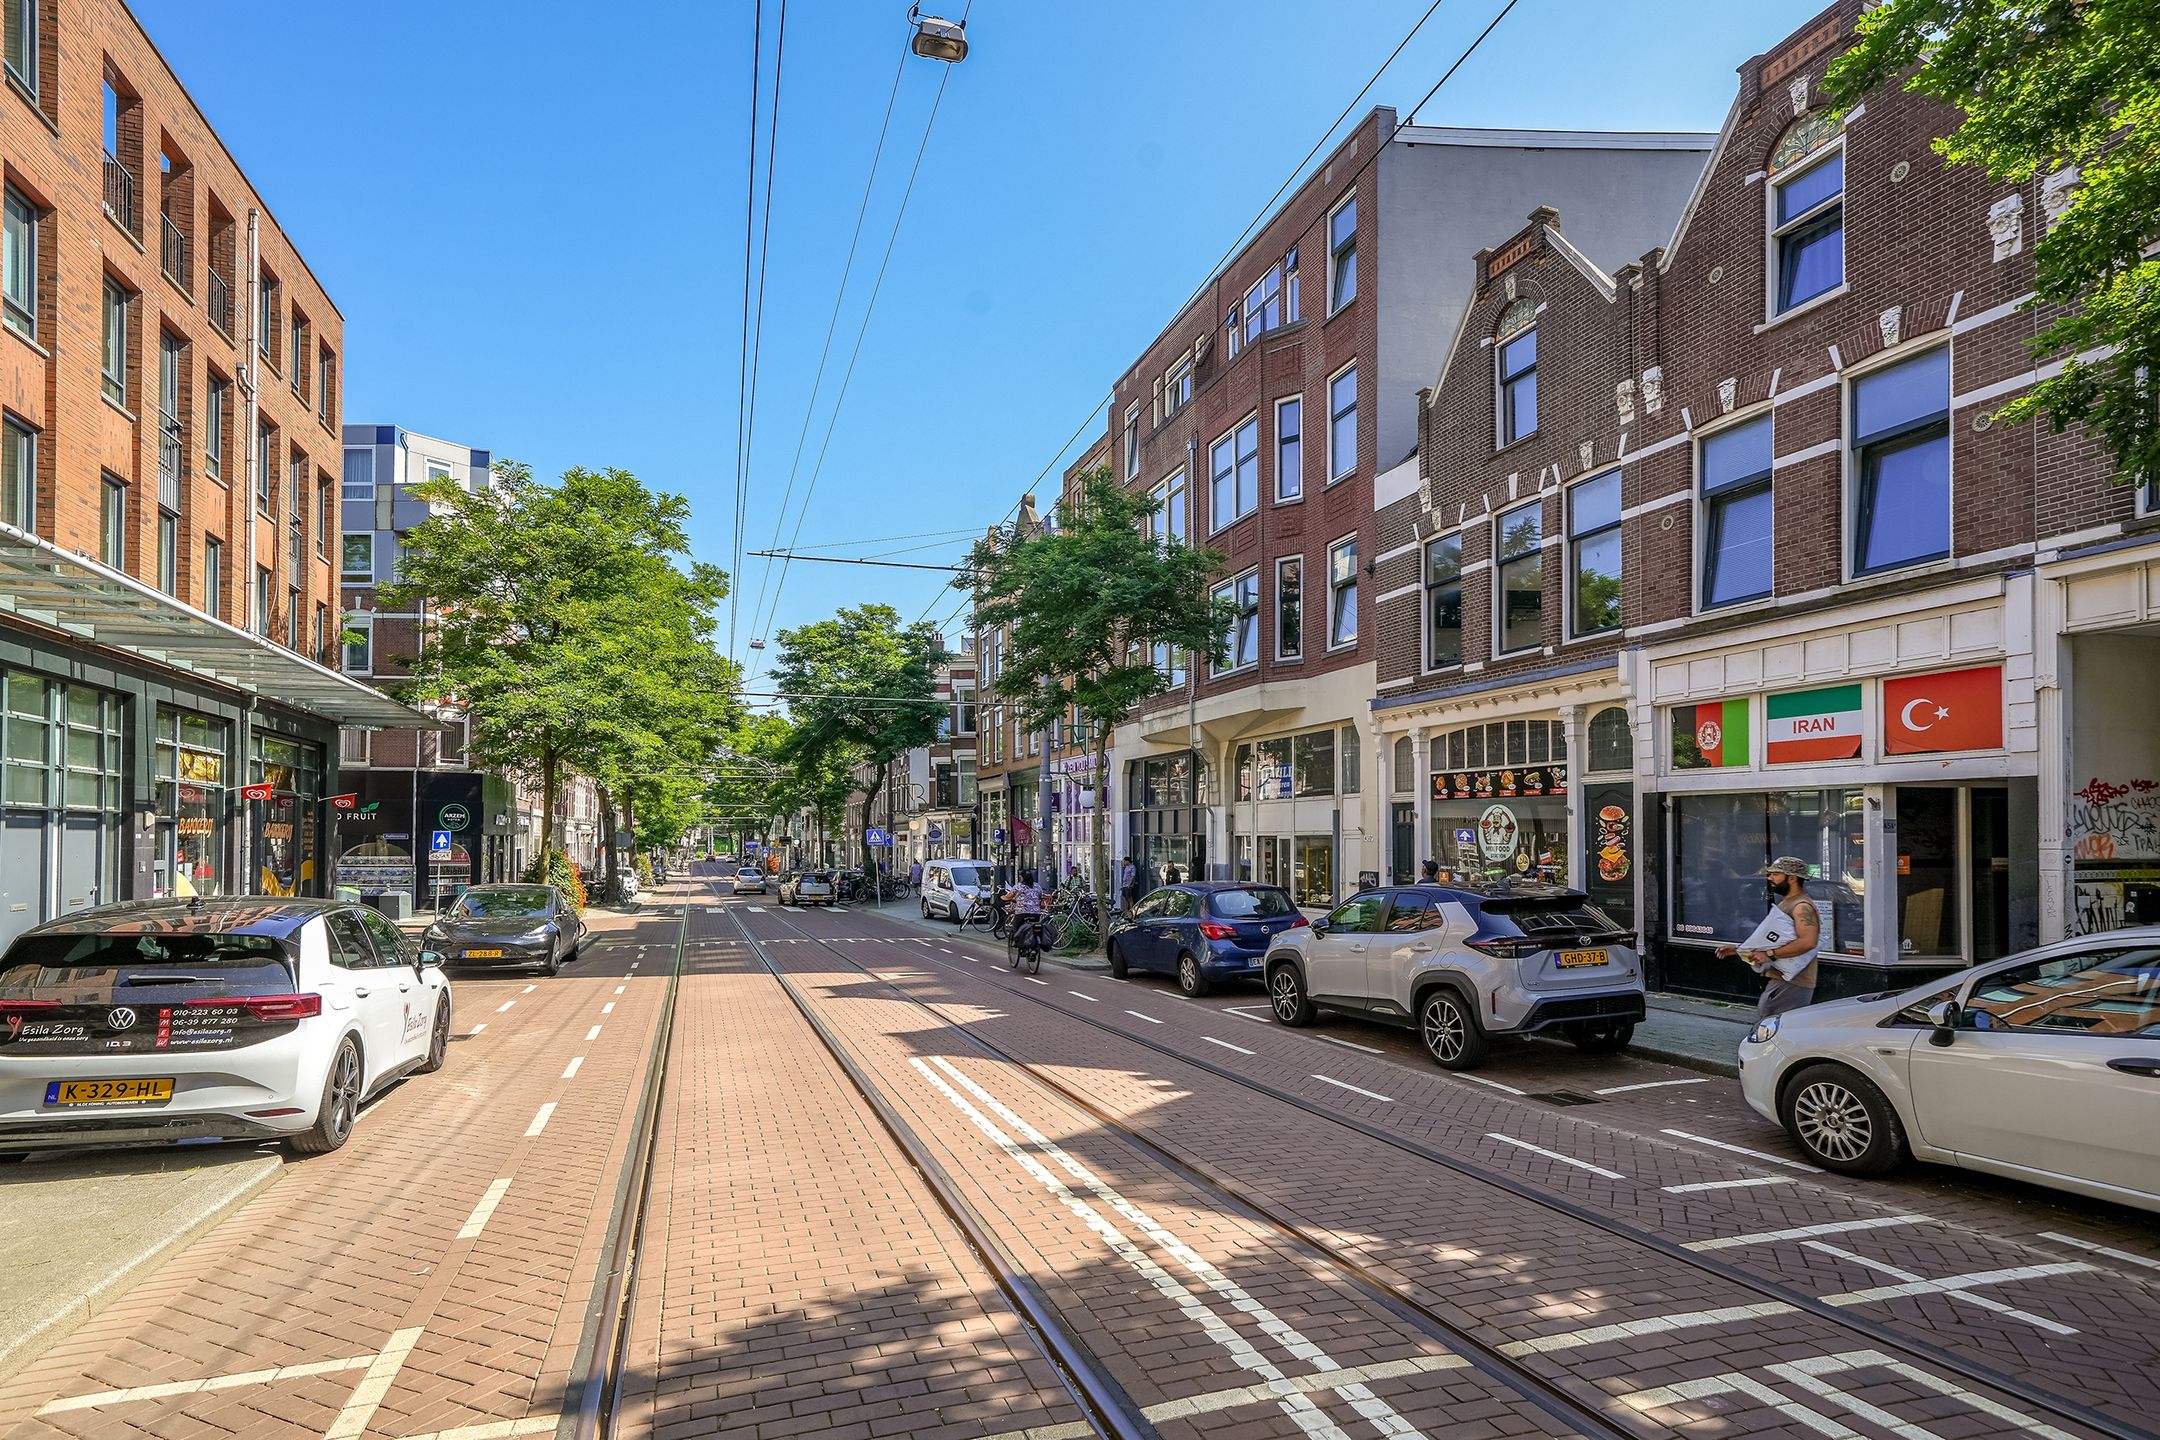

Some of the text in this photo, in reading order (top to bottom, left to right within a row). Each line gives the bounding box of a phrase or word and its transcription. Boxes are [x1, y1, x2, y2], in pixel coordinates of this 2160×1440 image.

[1793, 717, 1835, 734] IRAN
[346, 812, 377, 821] FRUIT
[994, 829, 1001, 838] P
[1564, 951, 1606, 964] GHD-37-B
[172, 1008, 209, 1017] 010-223
[211, 1008, 224, 1016] 60
[21, 1024, 84, 1037] Esila Zorg
[65, 1081, 163, 1100] K-329-HL
